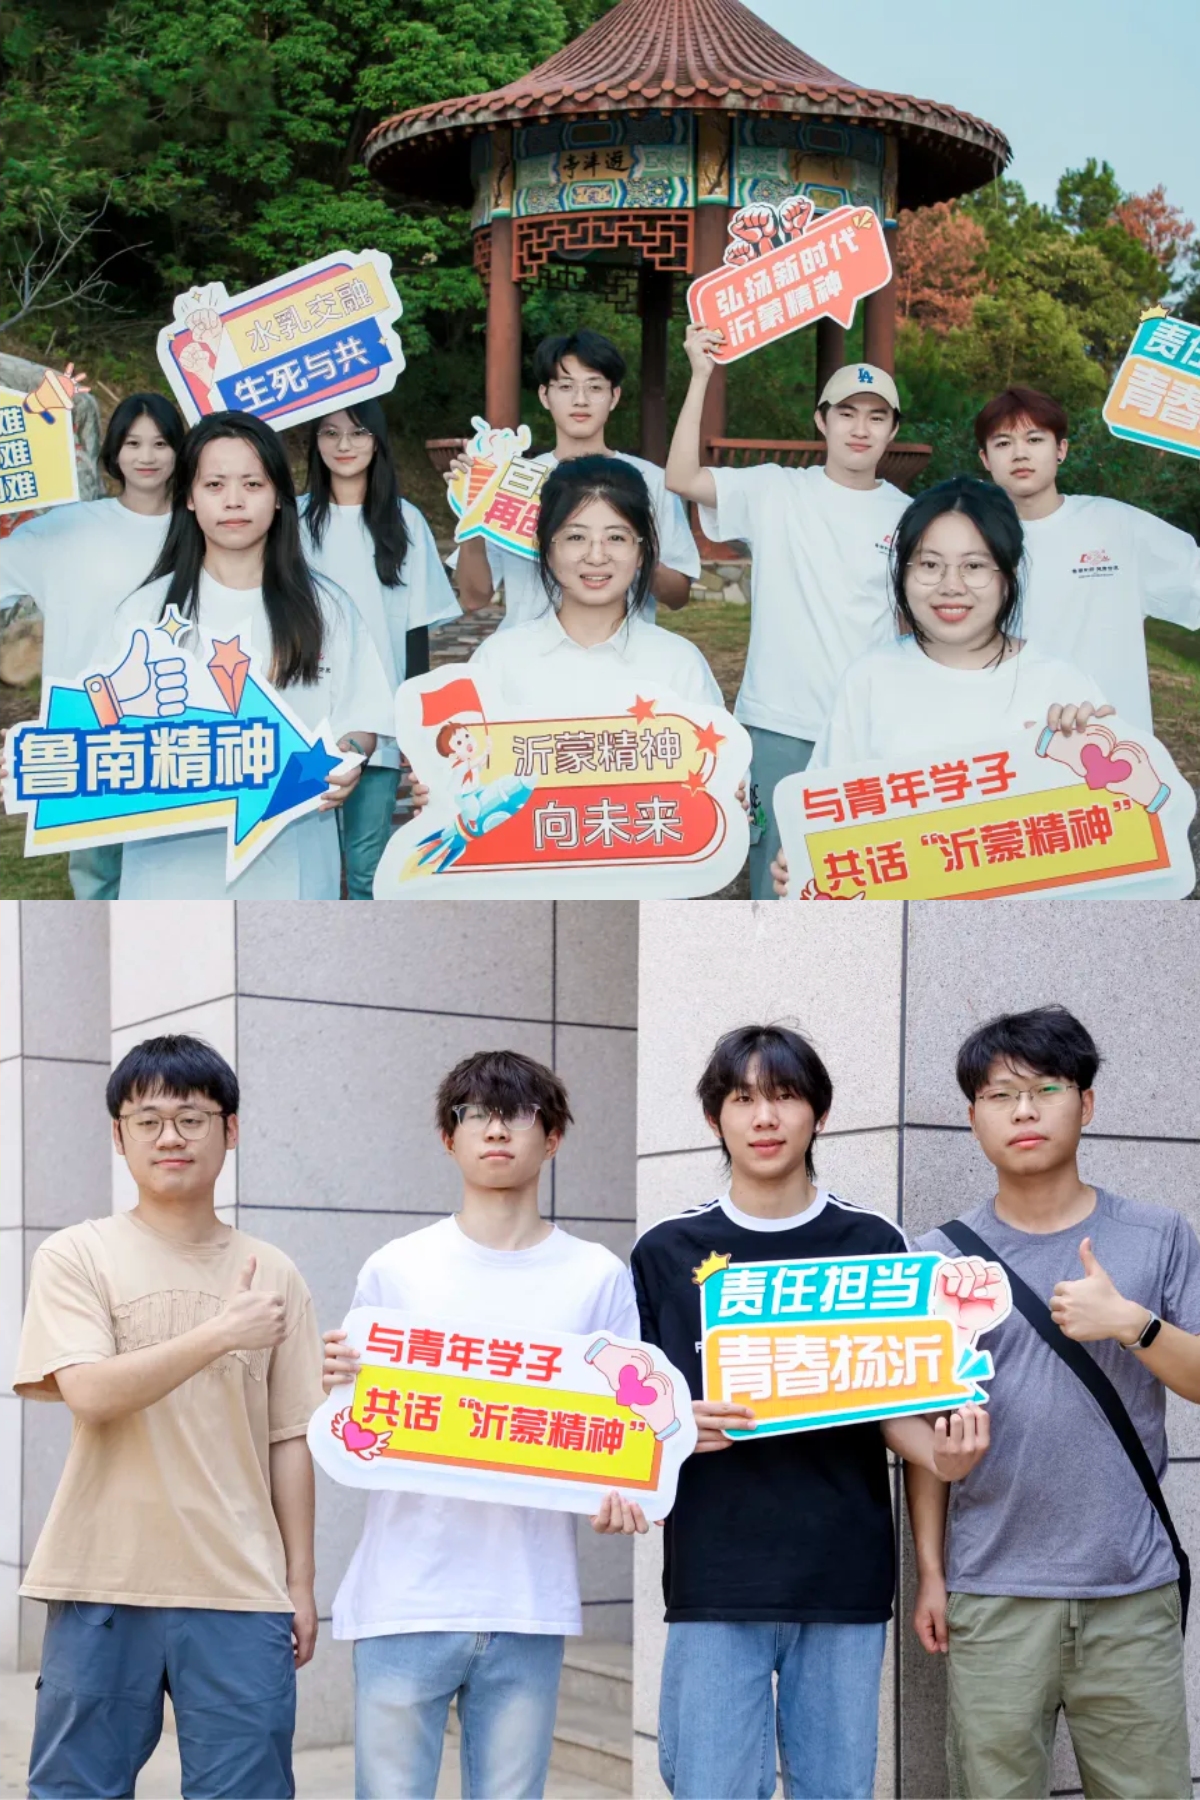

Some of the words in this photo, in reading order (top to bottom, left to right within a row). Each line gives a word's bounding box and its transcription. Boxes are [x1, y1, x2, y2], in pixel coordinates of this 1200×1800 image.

[716, 227, 859, 316] 弘扬新时代
[246, 276, 374, 353] 水乳交融
[728, 271, 843, 348] 沂蒙精神
[233, 336, 370, 412] 生死与共
[858, 367, 873, 384] LA
[19, 725, 276, 796] 鲁南精神
[512, 727, 682, 777] 沂蒙精神
[803, 750, 1017, 824] 与青年学子
[534, 794, 684, 850] 向未来
[718, 1264, 921, 1318] 责任担当
[365, 1322, 563, 1382] 与青年学子
[719, 1333, 943, 1401] 青春扬沂
